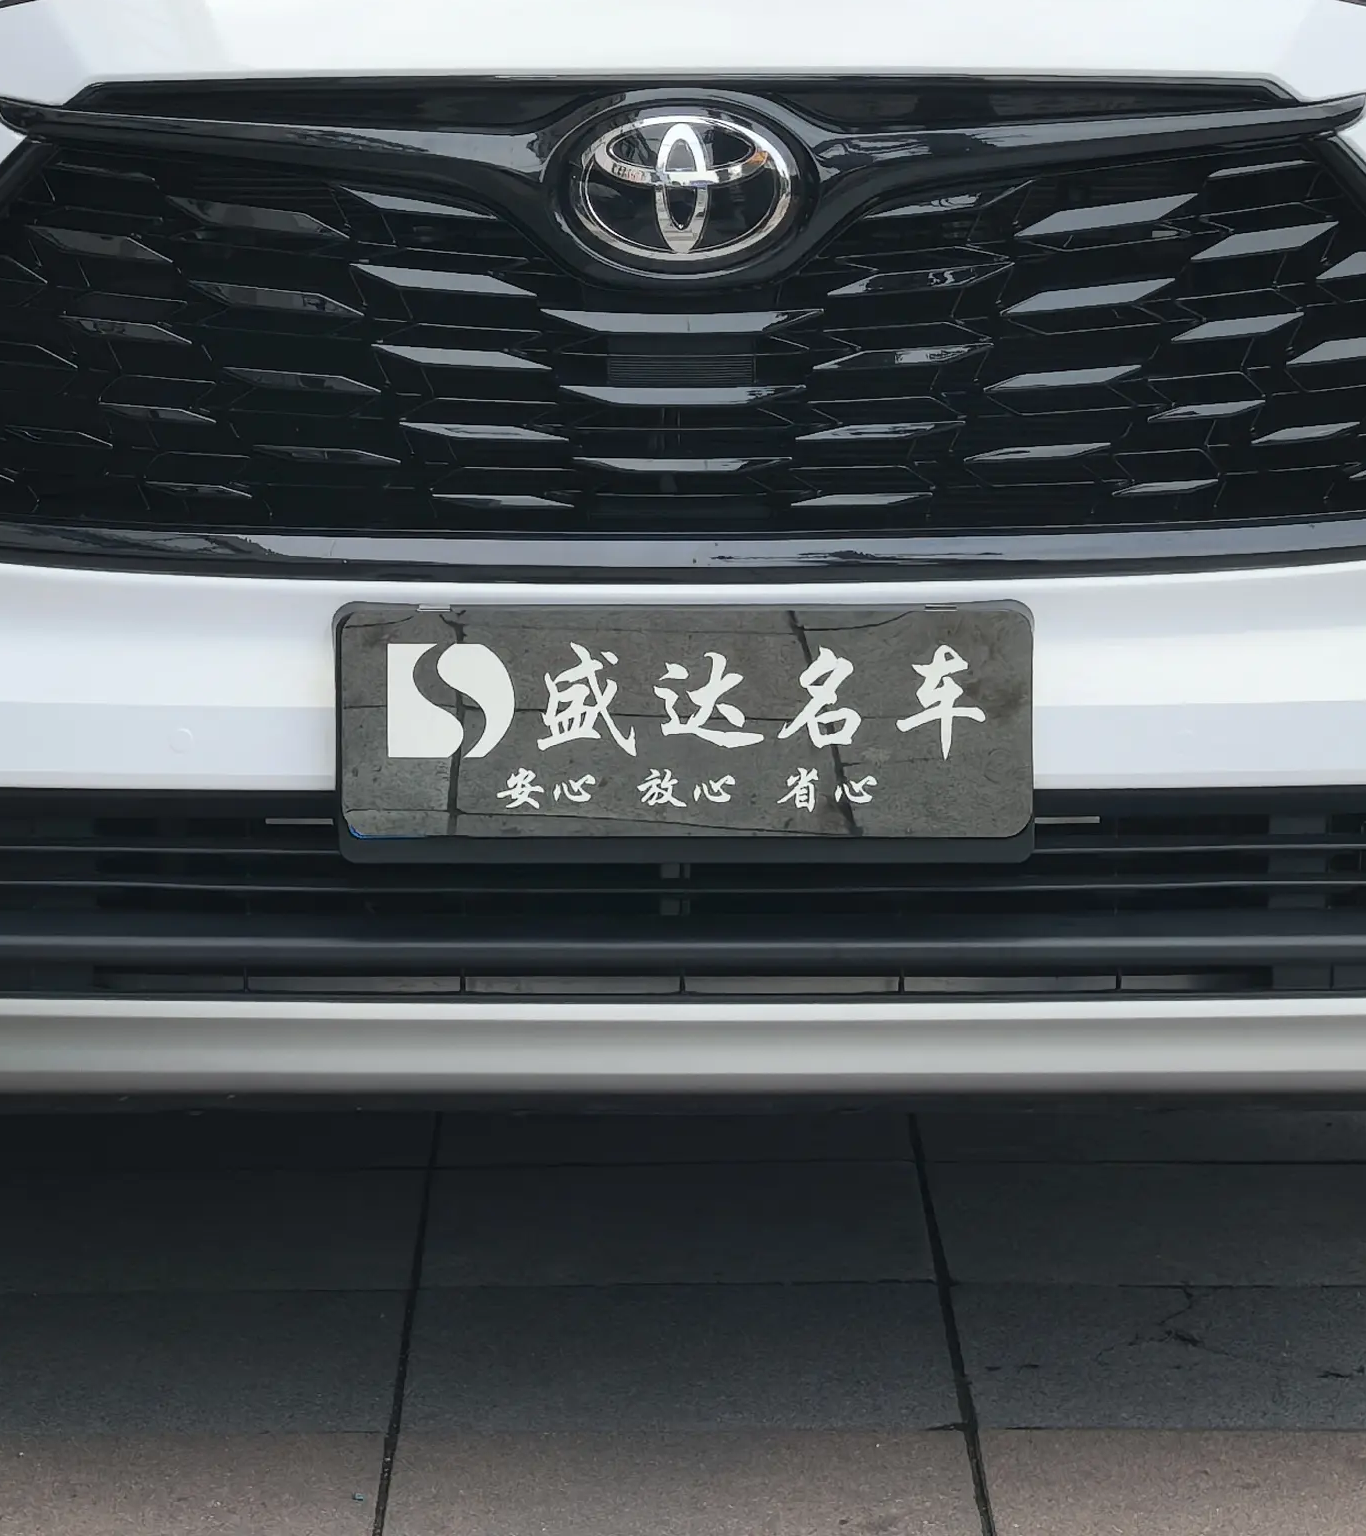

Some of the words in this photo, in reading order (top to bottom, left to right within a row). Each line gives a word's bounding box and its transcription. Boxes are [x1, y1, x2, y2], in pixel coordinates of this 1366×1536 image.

[537, 641, 986, 761] 盛达名车
[496, 767, 597, 810] 安心
[636, 767, 737, 809] 放心
[777, 767, 880, 812] 省心
